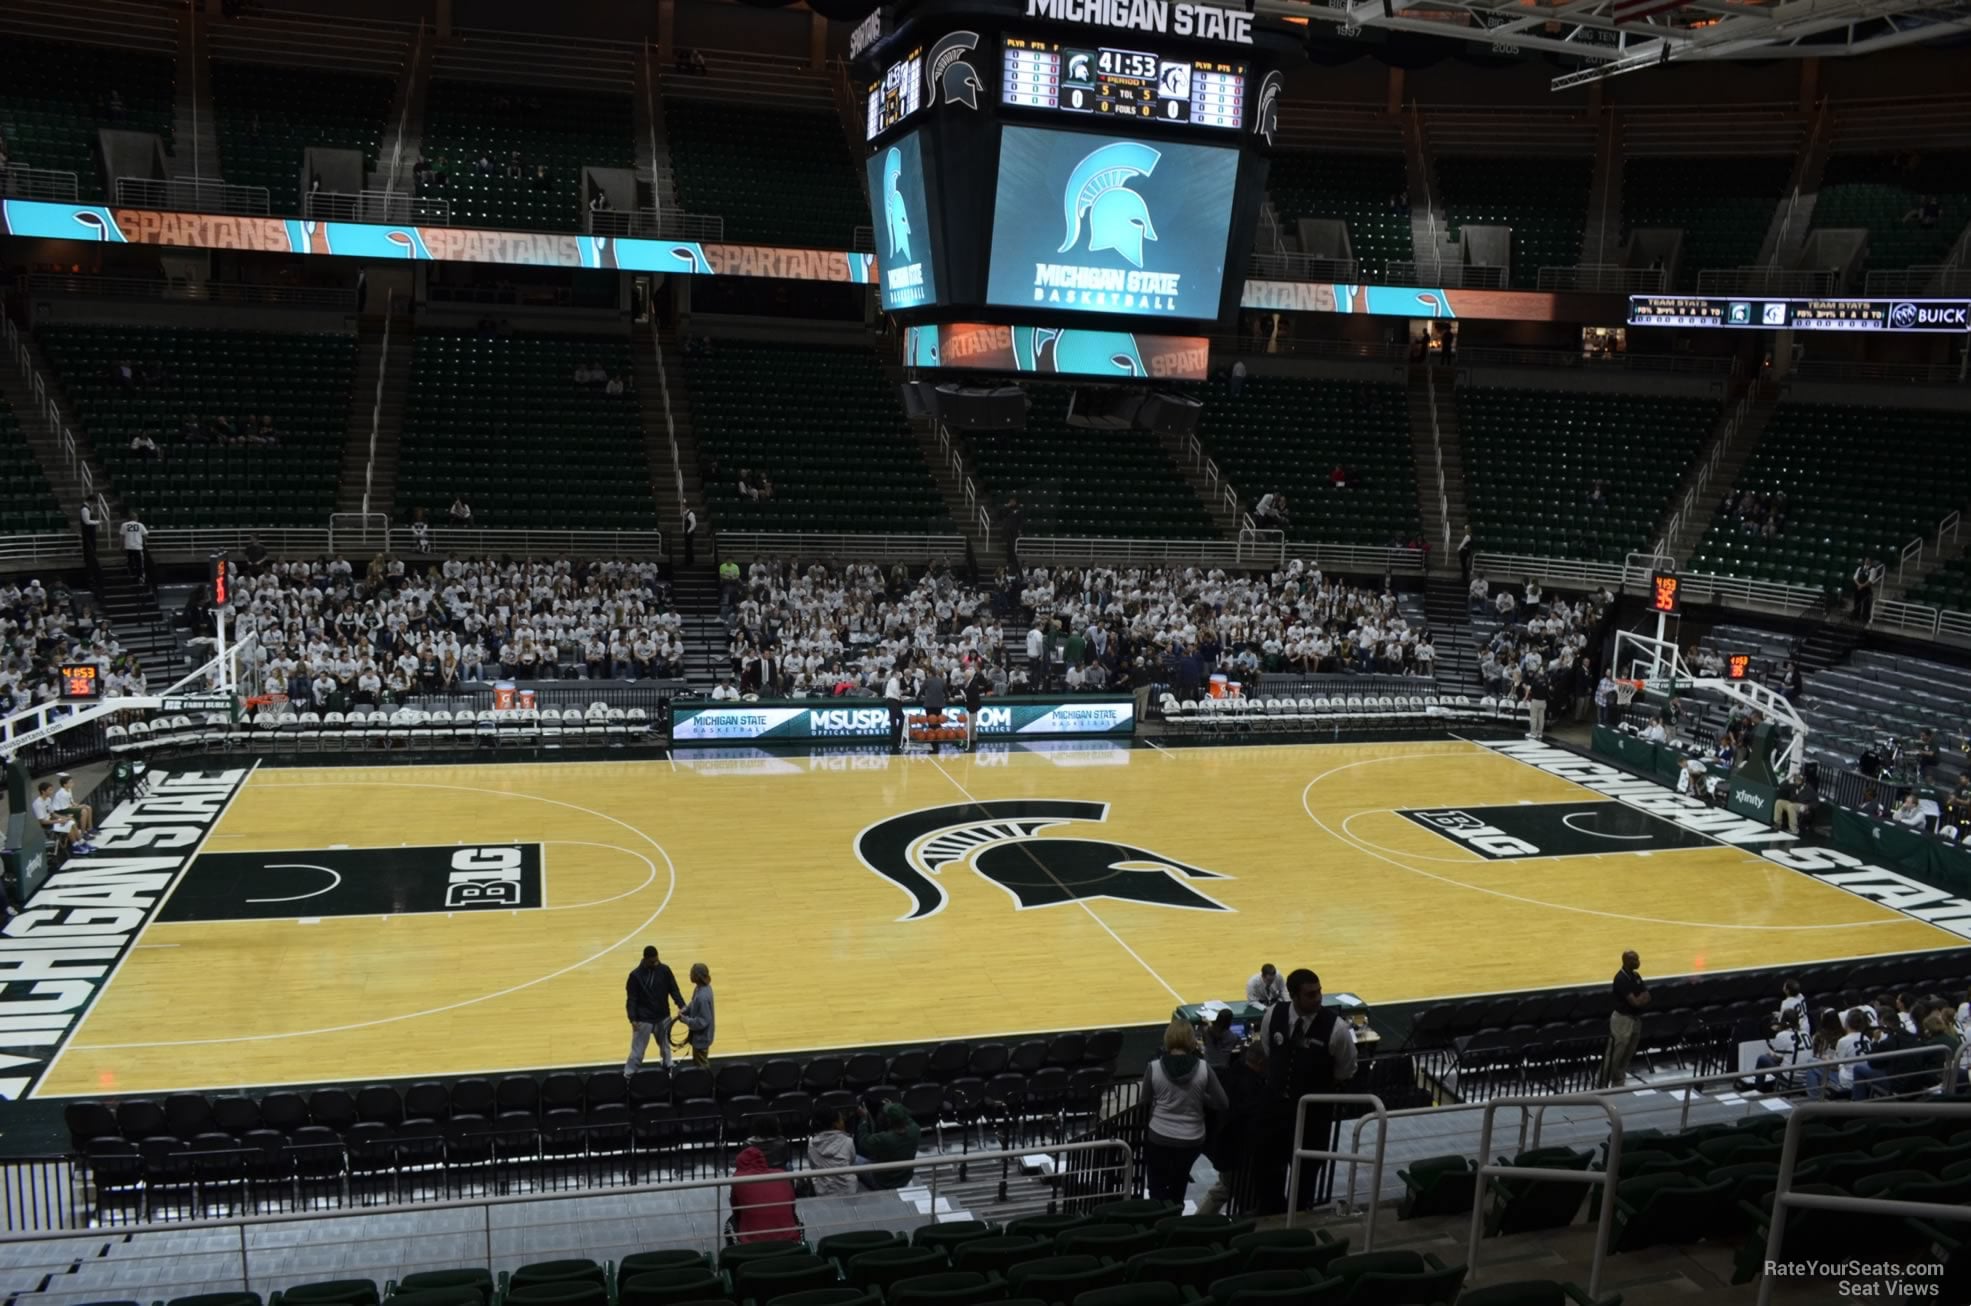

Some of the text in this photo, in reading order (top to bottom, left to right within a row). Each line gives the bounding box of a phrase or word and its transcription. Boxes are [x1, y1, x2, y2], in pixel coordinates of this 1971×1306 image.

[1026, 0, 1256, 45] MICHIGAN STATE
[1099, 51, 1156, 77] 41:53
[1107, 76, 1140, 86] PERIOD
[1072, 89, 1083, 108] 0
[1102, 85, 1150, 100] 5 TOL 5
[1101, 101, 1150, 116] 0 FOULS 0
[1168, 100, 1178, 118] 0
[117, 209, 290, 252] SPARTANS
[425, 229, 579, 268] SPARTANS
[708, 244, 849, 282] SPARTANS
[1034, 263, 1181, 296] MICHIGAN STATE
[1034, 287, 1176, 311] BASKETBALL
[1918, 308, 1966, 323] BUICK
[127, 523, 140, 533] 20
[1656, 589, 1673, 610] 35
[71, 679, 89, 694] 35
[693, 715, 768, 726] MICHIGAN STATE
[1052, 710, 1118, 720] MICHIGAN STATE
[1473, 739, 1801, 844] MICHIGAN
[1735, 789, 1764, 809] xfinity
[88, 768, 248, 849] STATE
[1761, 846, 1971, 939] STAT
[1794, 999, 1808, 1020] 20
